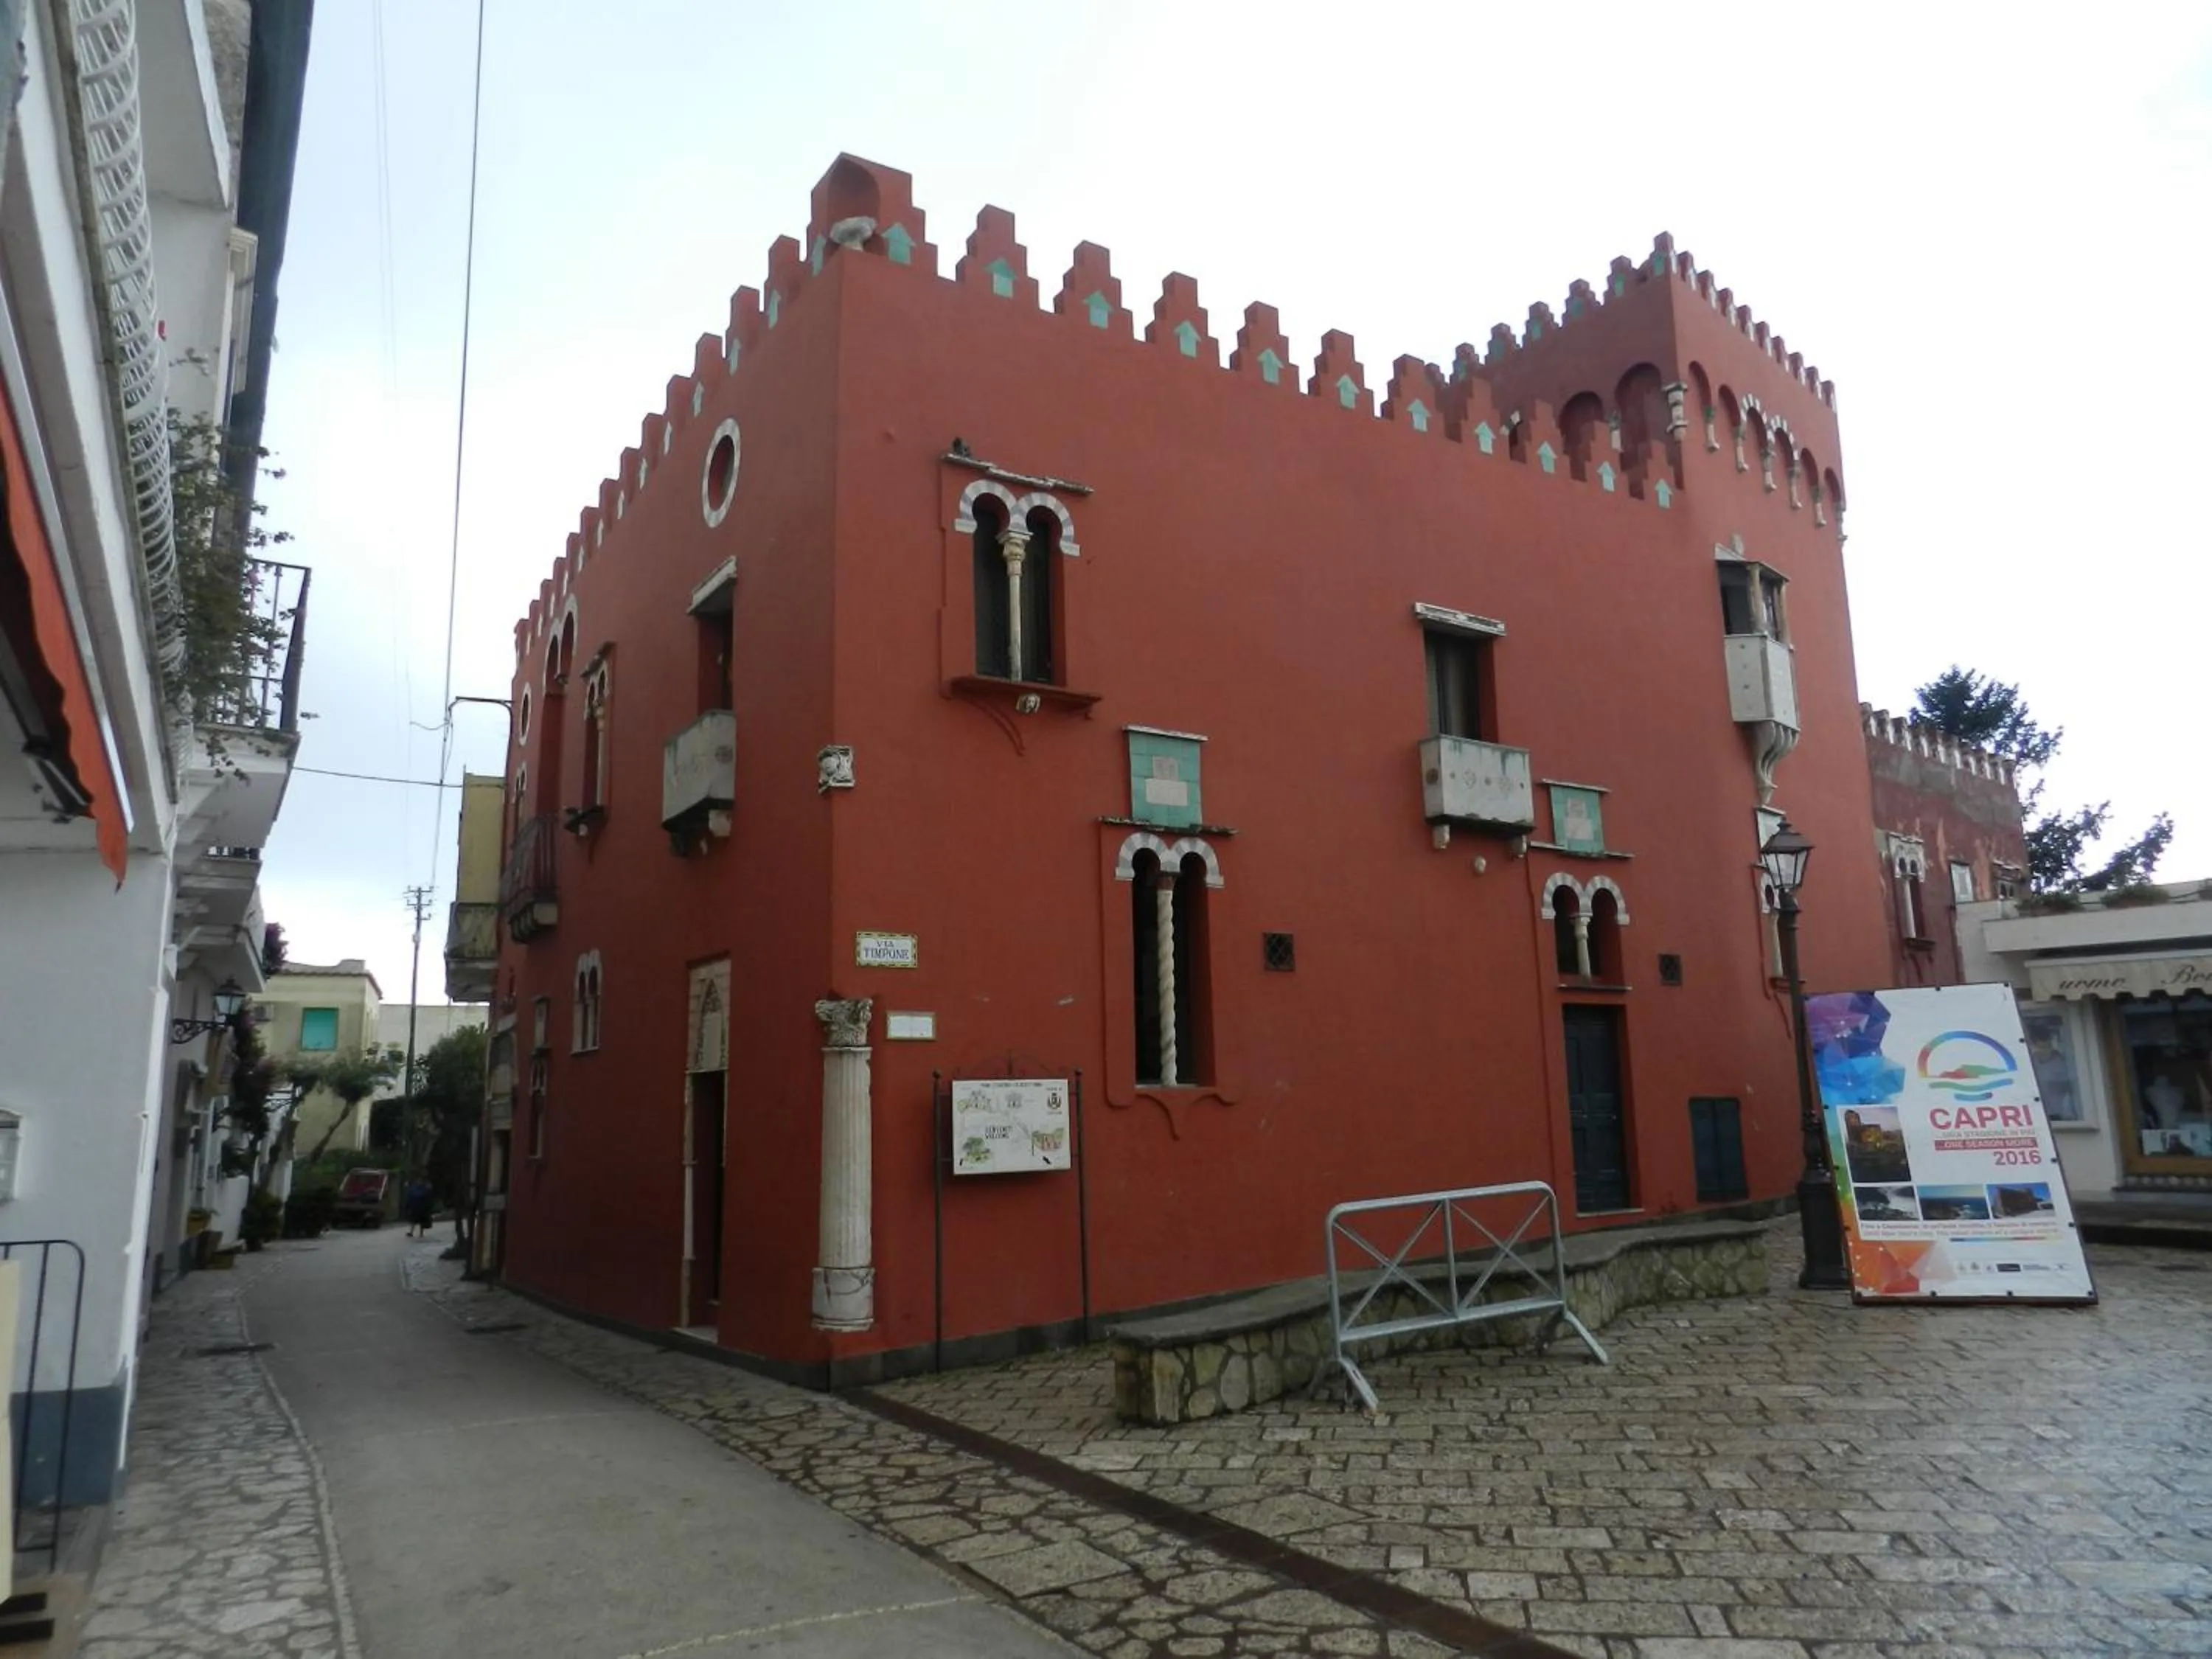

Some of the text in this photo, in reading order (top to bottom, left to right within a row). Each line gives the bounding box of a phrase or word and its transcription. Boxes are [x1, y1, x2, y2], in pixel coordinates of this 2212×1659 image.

[863, 947, 910, 959] TIMPONE
[1930, 1105, 2033, 1130] CAPRI
[1993, 1150, 2042, 1165] 2016
